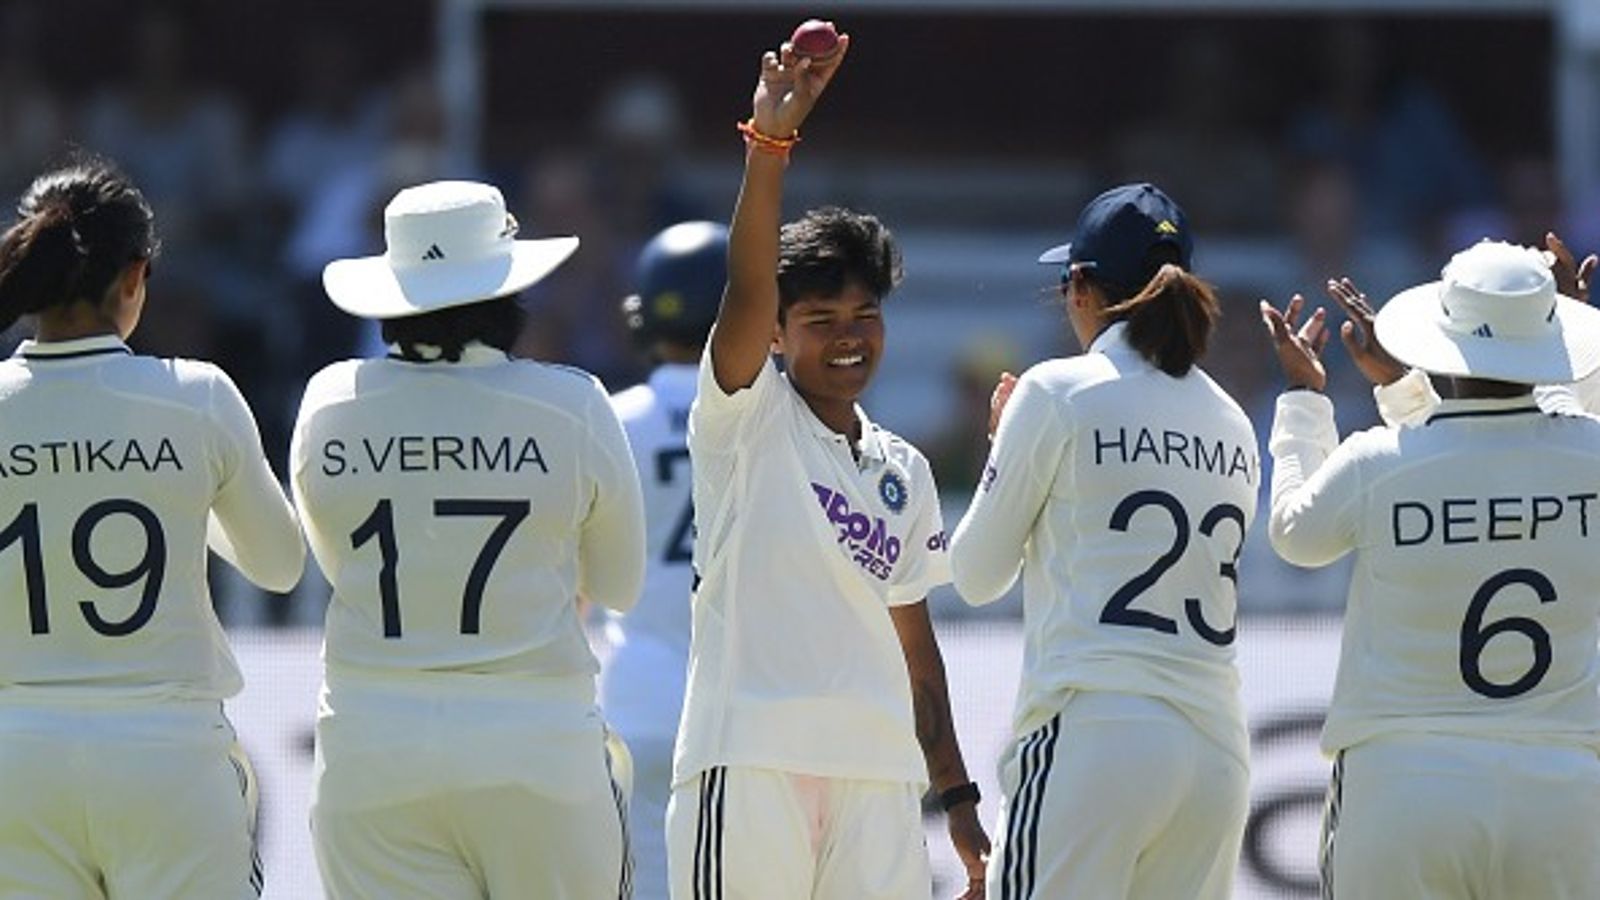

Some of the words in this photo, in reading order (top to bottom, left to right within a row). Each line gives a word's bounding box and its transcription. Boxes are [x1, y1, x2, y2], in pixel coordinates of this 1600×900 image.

[0, 437, 183, 478] STIKAA
[322, 436, 549, 476] S.VERMA
[1094, 427, 1259, 485] HARMA
[0, 499, 167, 636] 19
[350, 498, 531, 638] 17
[1099, 490, 1246, 646] 23
[1459, 568, 1558, 698] 6
